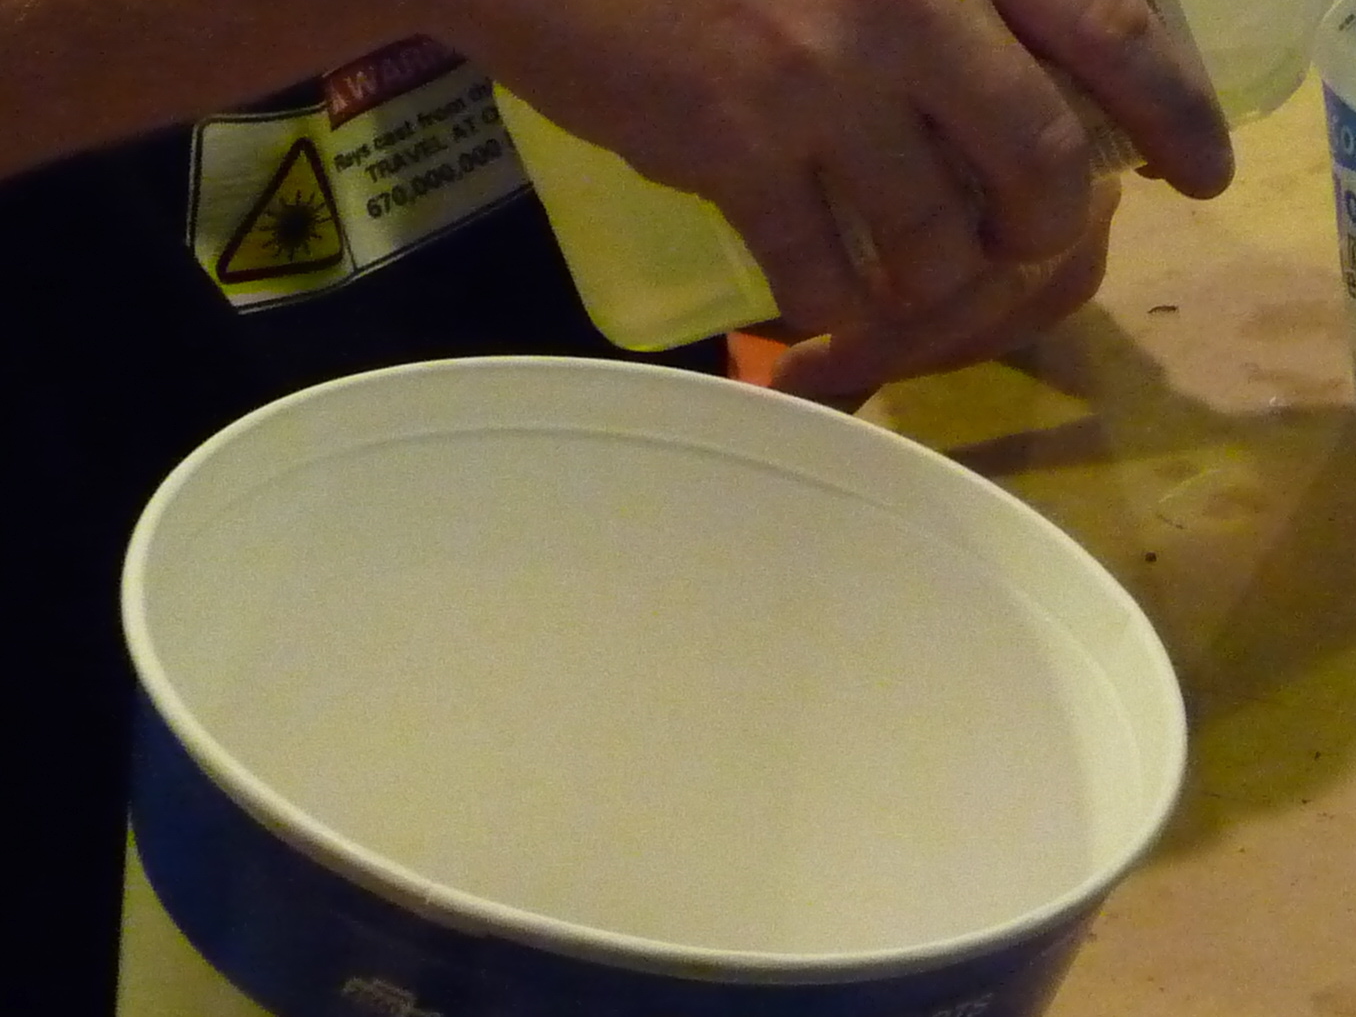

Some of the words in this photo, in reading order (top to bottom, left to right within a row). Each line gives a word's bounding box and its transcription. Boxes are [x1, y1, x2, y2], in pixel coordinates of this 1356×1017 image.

[366, 137, 449, 184] TRAVEL
[453, 116, 479, 142] AT
[367, 138, 503, 220] 670,000,000
